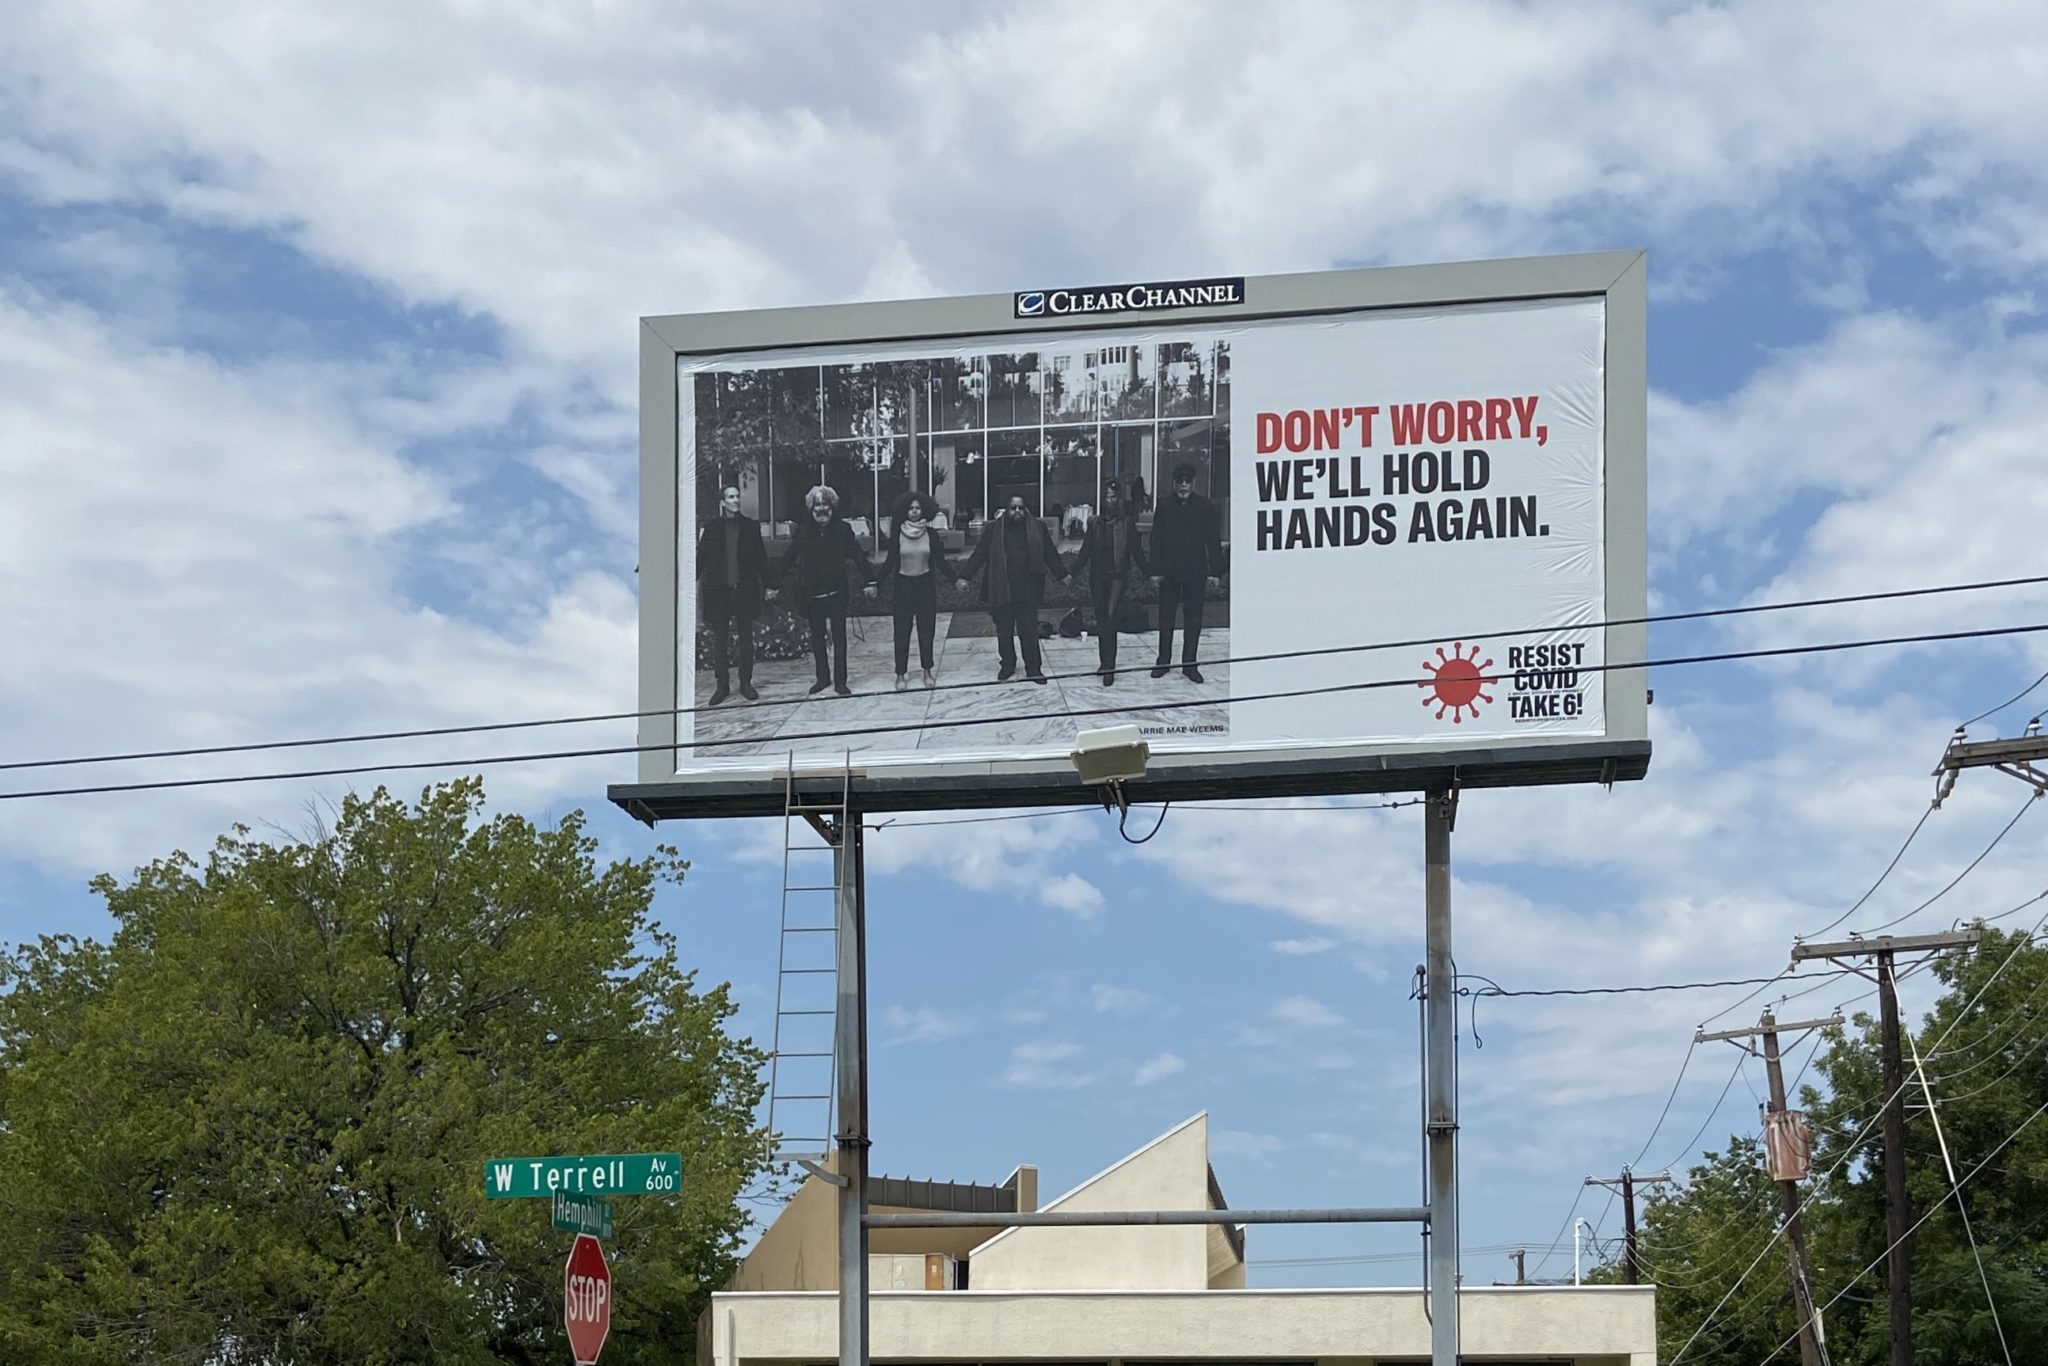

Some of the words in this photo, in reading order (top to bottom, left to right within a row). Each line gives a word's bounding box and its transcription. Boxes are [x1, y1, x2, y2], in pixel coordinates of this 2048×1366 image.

[1256, 406, 1380, 454] DON'T
[1390, 396, 1548, 447] WORRY,
[1255, 456, 1371, 502] WE'LL
[1383, 449, 1490, 495] HOLD
[1256, 502, 1397, 551] HANDS
[1407, 495, 1550, 543] AGAIN.
[1508, 643, 1585, 668] RESIST
[1514, 666, 1578, 691] COVID
[1507, 694, 1560, 718] TAKE
[1563, 693, 1583, 715] 6!
[1166, 725, 1187, 734] MAE
[1189, 724, 1225, 733] WEEMS
[494, 1164, 514, 1192] W
[530, 1160, 625, 1190] Terrell
[650, 1157, 667, 1173] Av
[645, 1174, 674, 1191] 600
[557, 1192, 602, 1232] Hemphill
[568, 1274, 607, 1323] STOP
